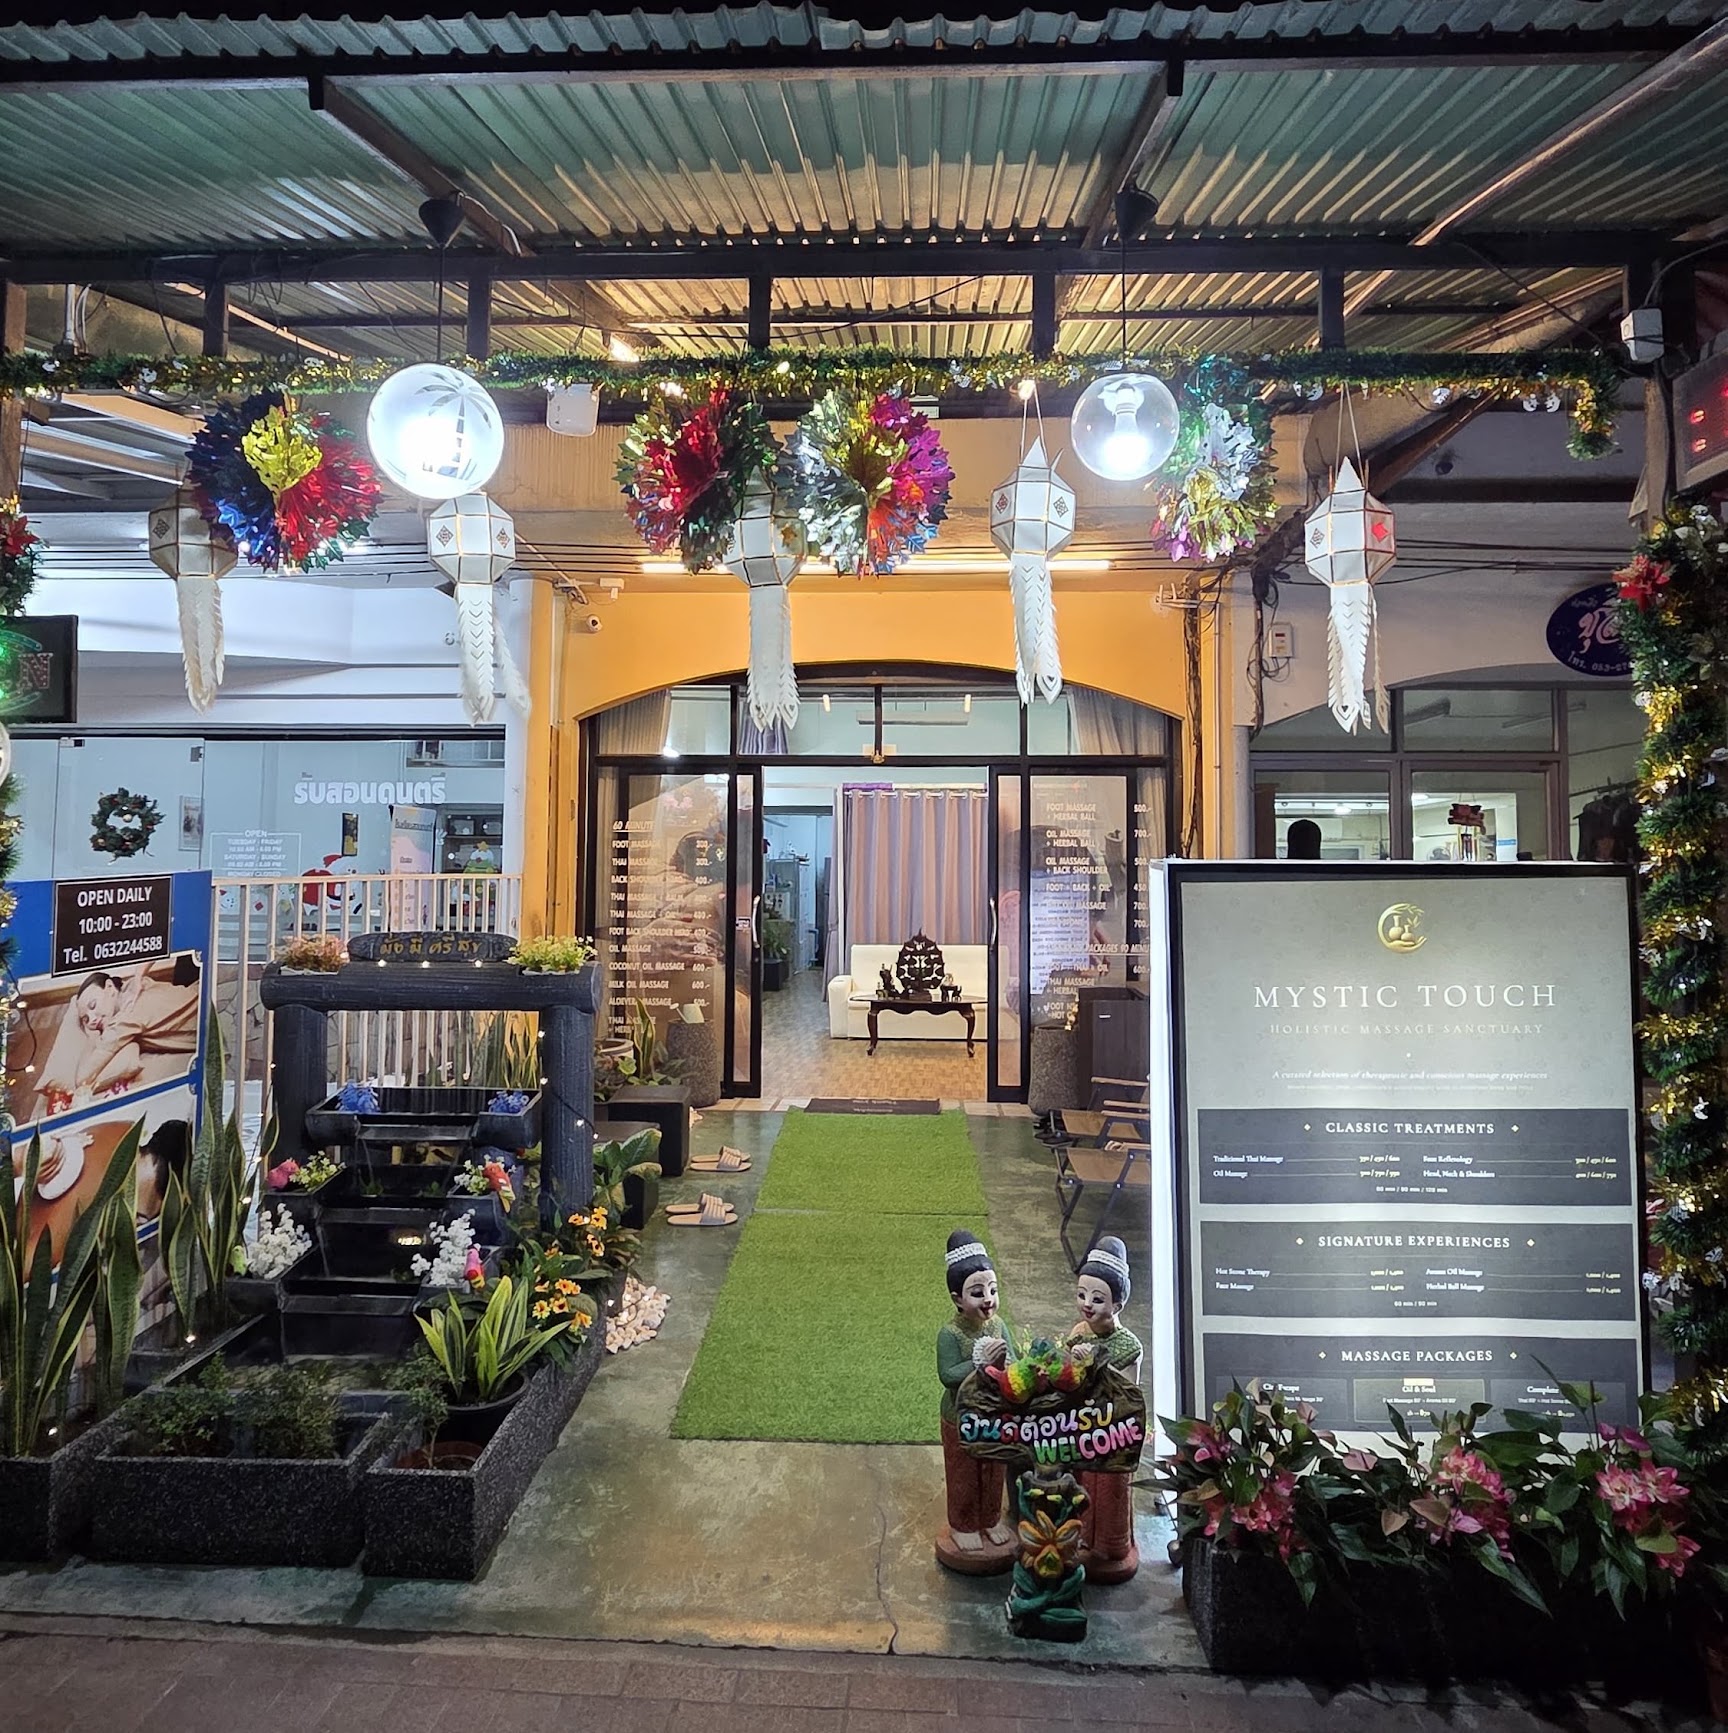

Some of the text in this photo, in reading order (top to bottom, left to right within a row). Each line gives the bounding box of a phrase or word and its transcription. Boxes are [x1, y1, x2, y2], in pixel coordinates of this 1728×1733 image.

[1066, 803, 1096, 812] MASSAGE
[1060, 829, 1091, 838] MASSAGE
[1058, 857, 1090, 865] MASSAGE
[77, 886, 153, 907] OPEN DAILY
[79, 914, 112, 935] 10:00
[121, 911, 153, 930] 23:00
[63, 935, 163, 965] Tel. 0632244588
[621, 944, 652, 953] MASSAGE
[1130, 944, 1149, 953] MINU
[608, 962, 640, 971] COCONUT
[655, 962, 685, 971] MASSAGE
[639, 980, 669, 989] MASSAGE
[1064, 977, 1095, 986] MASSAGE
[1253, 983, 1557, 1008] MYSTIC TOUCH
[1269, 1023, 1544, 1035] HOLISTIC MASSAGE SANCTUARY
[1325, 1122, 1495, 1135] CLASSIC TREATMENTS
[1318, 1235, 1510, 1249] SIGNATURE EXPERIENCES
[1341, 1350, 1493, 1362] MASSAGE PACKAGES
[960, 1399, 1113, 1444] ยินดีต้อนรับ
[1033, 1417, 1143, 1464] WELCOME
